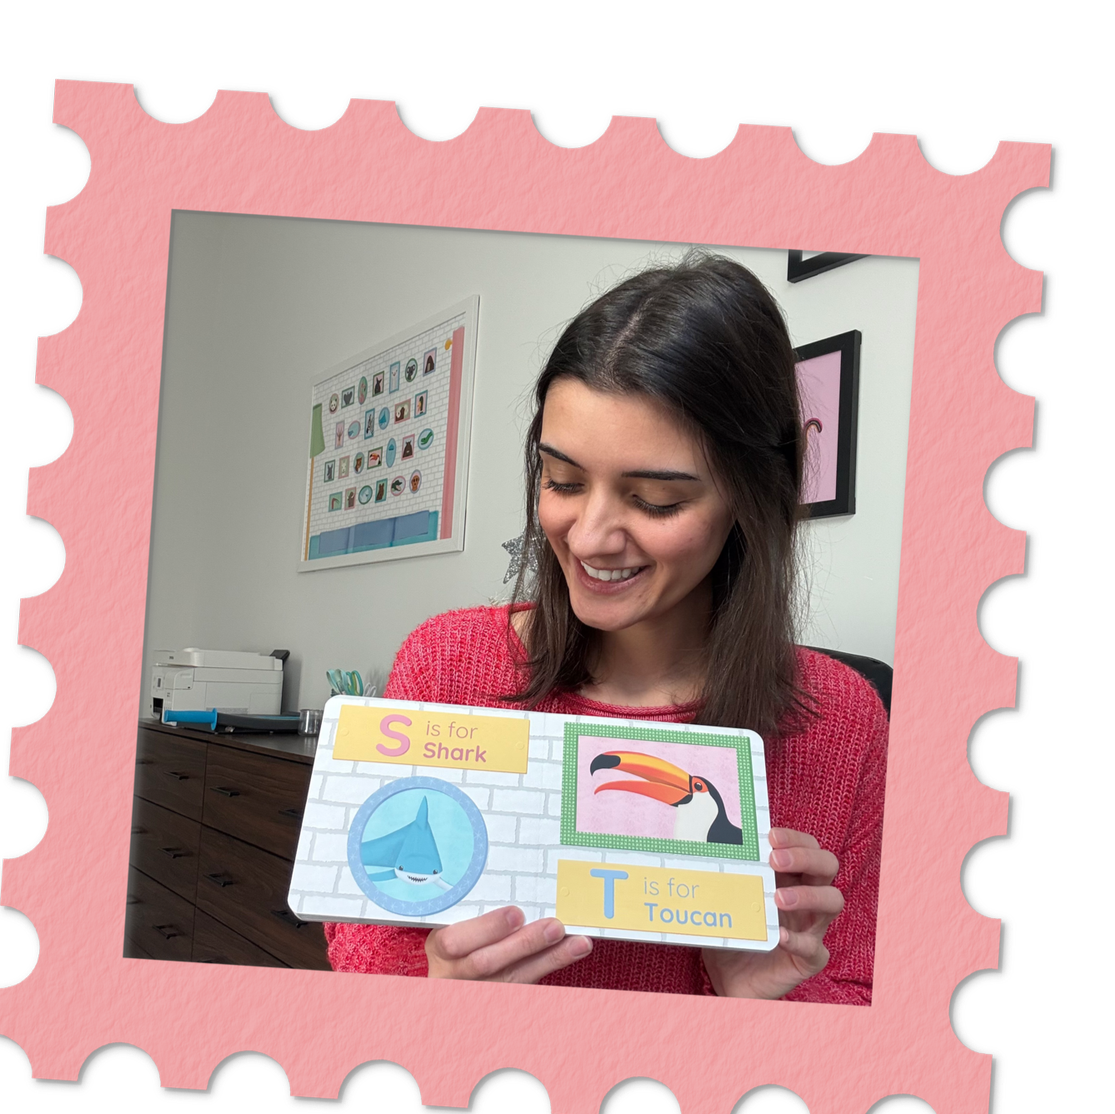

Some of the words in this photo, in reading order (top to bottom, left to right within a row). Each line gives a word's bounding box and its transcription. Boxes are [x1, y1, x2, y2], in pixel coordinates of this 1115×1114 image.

[375, 713, 413, 757] S
[426, 720, 442, 737] is
[448, 721, 479, 740] for
[422, 741, 487, 763] Shark
[590, 869, 629, 919] T
[644, 877, 660, 896] is
[667, 878, 700, 899] for
[644, 902, 733, 929] Toucan
